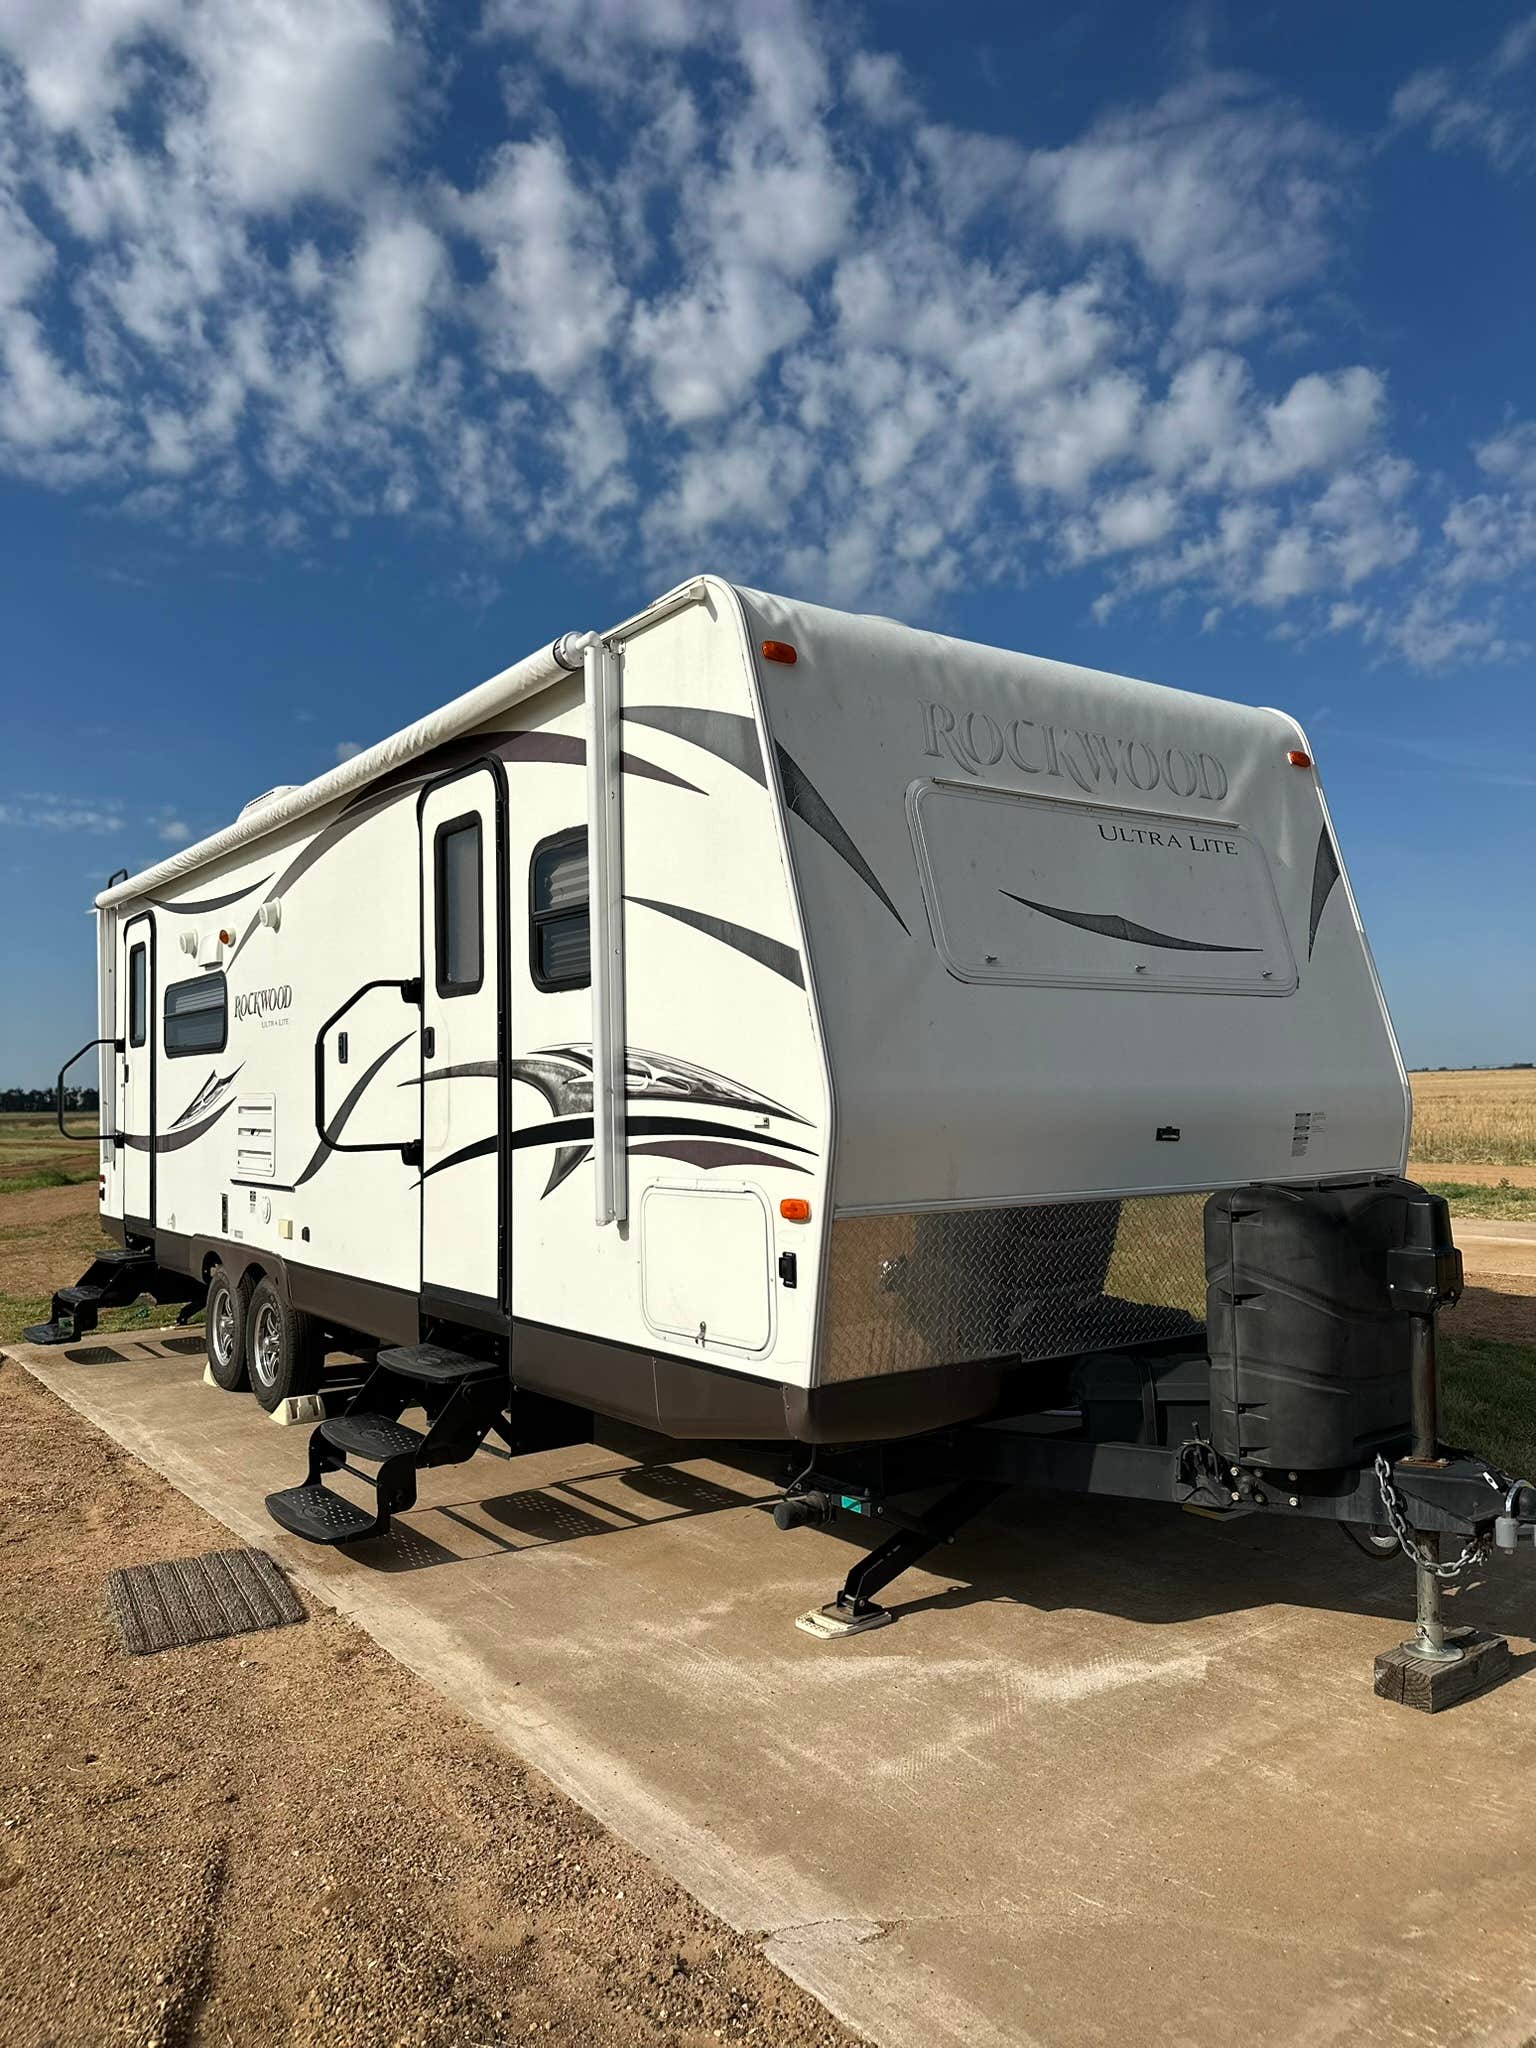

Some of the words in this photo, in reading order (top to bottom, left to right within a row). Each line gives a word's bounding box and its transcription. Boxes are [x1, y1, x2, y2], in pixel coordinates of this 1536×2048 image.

[921, 701, 1229, 801] ROCKWOOD
[1098, 824, 1182, 849] ULTRA
[1190, 836, 1239, 856] LITE
[234, 984, 292, 1021] ROCKWOOD
